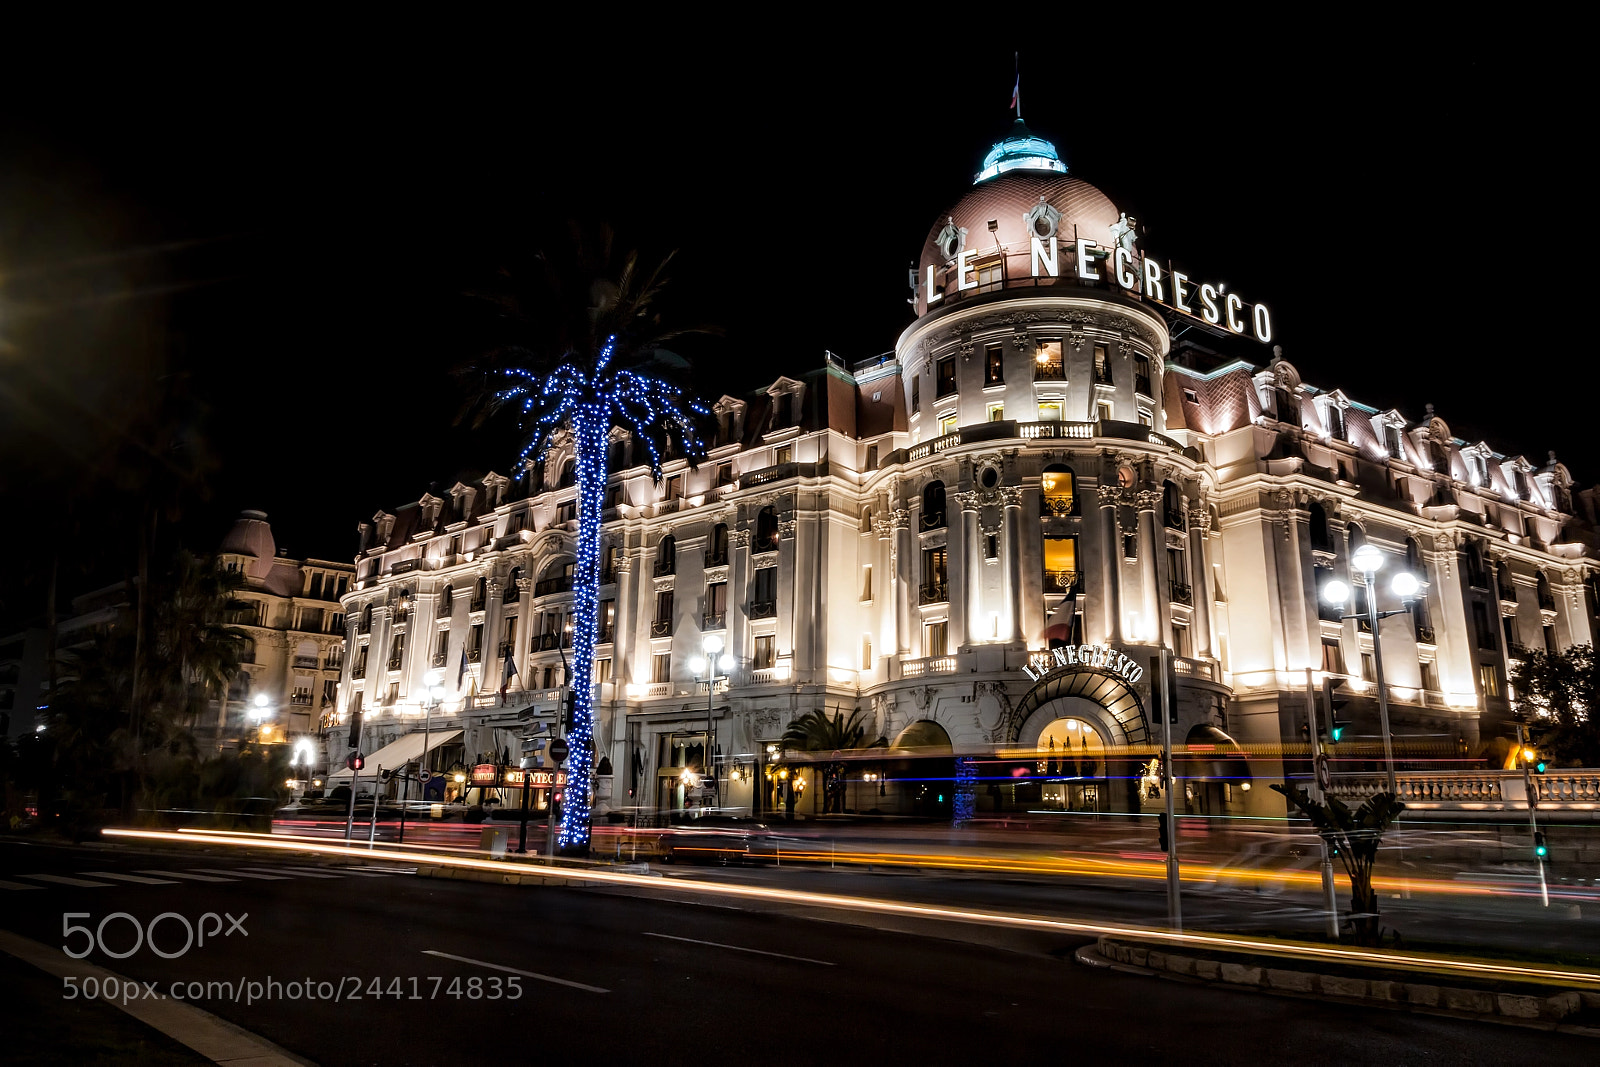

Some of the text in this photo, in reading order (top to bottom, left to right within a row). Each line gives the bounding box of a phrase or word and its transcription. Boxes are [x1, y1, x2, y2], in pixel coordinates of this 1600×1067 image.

[926, 236, 1273, 344] LE NEGRESCO
[1022, 644, 1144, 683] LE NEGRESCO
